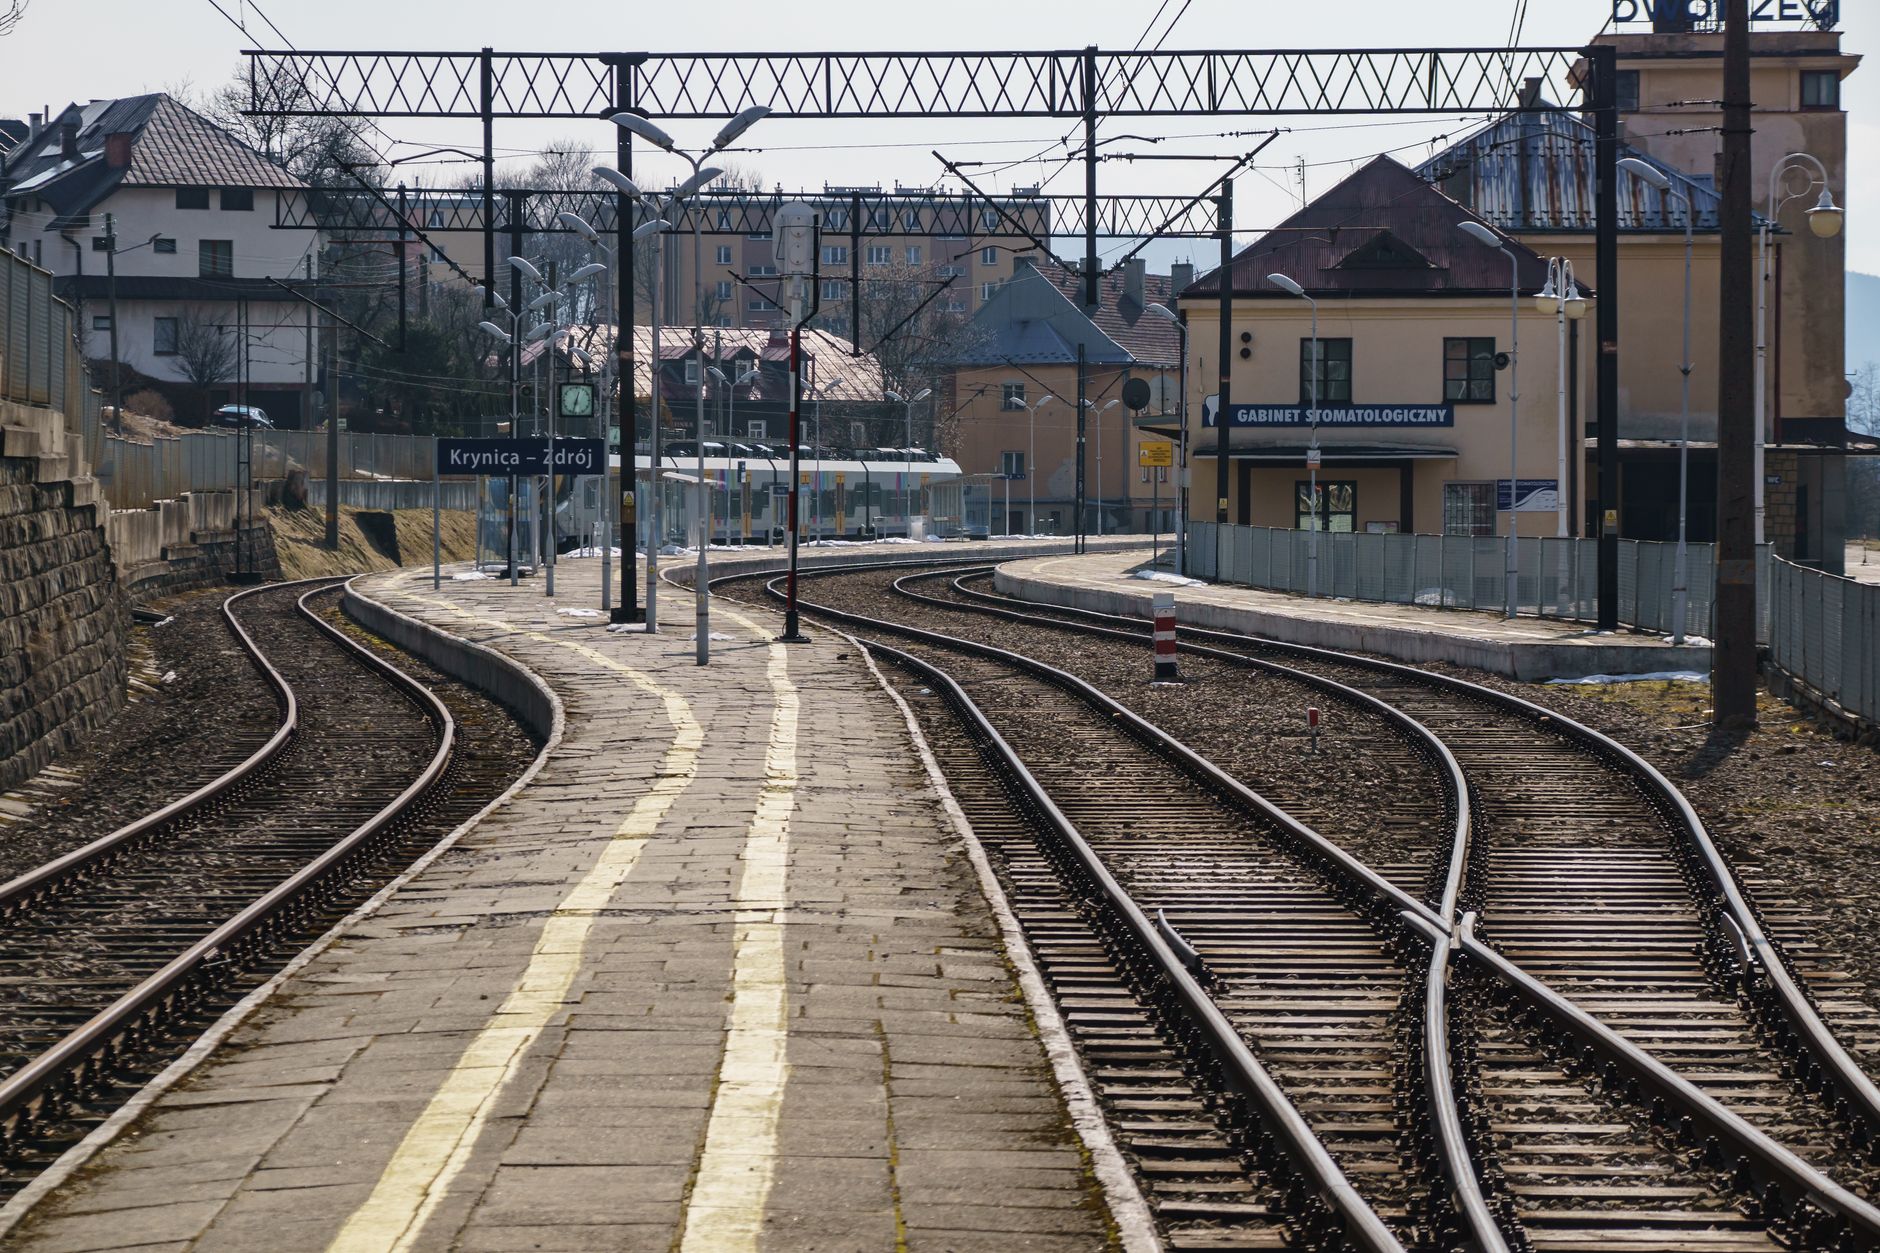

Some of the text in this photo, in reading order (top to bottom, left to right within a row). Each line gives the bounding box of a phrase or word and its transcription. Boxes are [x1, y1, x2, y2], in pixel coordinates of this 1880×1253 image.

[1613, 0, 1833, 22] DWOZEC
[1237, 409, 1447, 423] GABINET STOMATOLOGICZNY
[450, 448, 520, 469] Krynica
[542, 448, 593, 469] Zdrój
